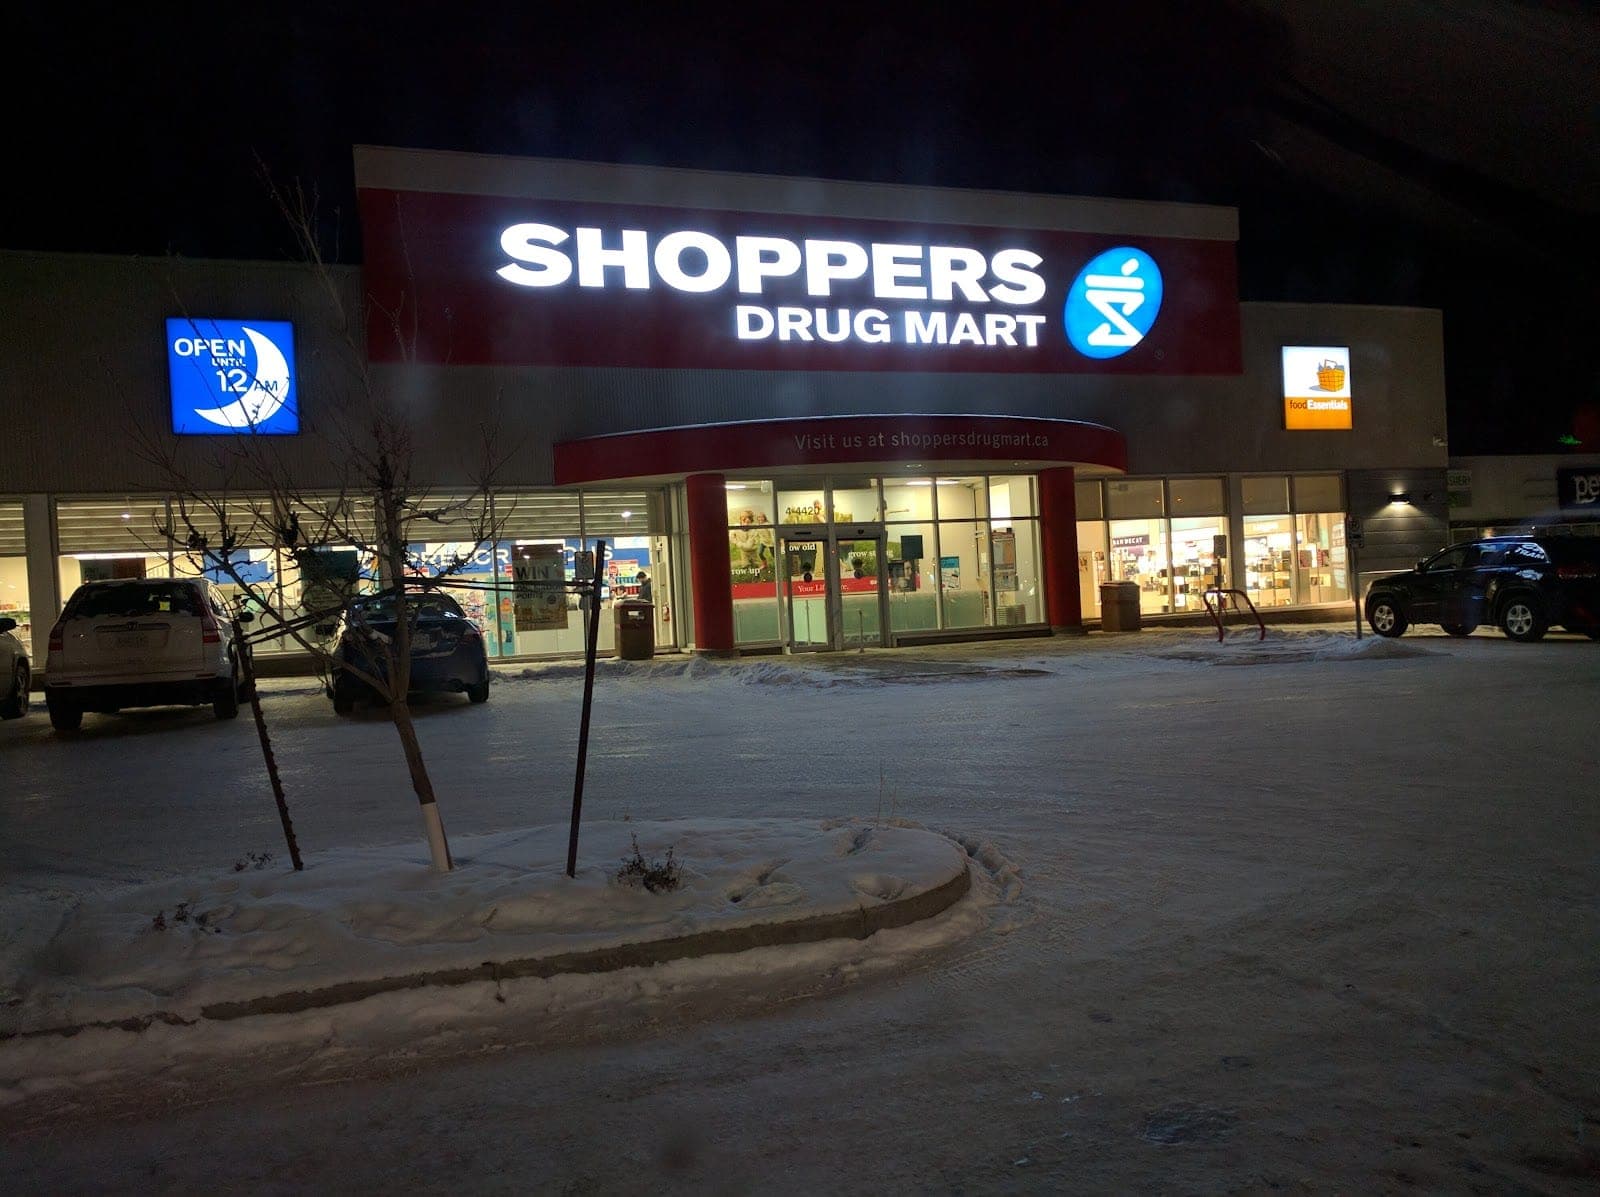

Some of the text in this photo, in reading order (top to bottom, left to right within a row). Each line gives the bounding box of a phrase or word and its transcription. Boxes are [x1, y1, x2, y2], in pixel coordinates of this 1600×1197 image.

[496, 223, 1046, 305] SHOPPERS
[737, 305, 1046, 347] DRUG MART
[174, 337, 246, 357] OPEN
[211, 357, 246, 367] UNTIL
[216, 368, 278, 392] 12 AM
[794, 432, 1049, 449] Visit us at shoppersdrugmart.ca
[802, 543, 816, 552] old
[515, 566, 550, 580] WIN
